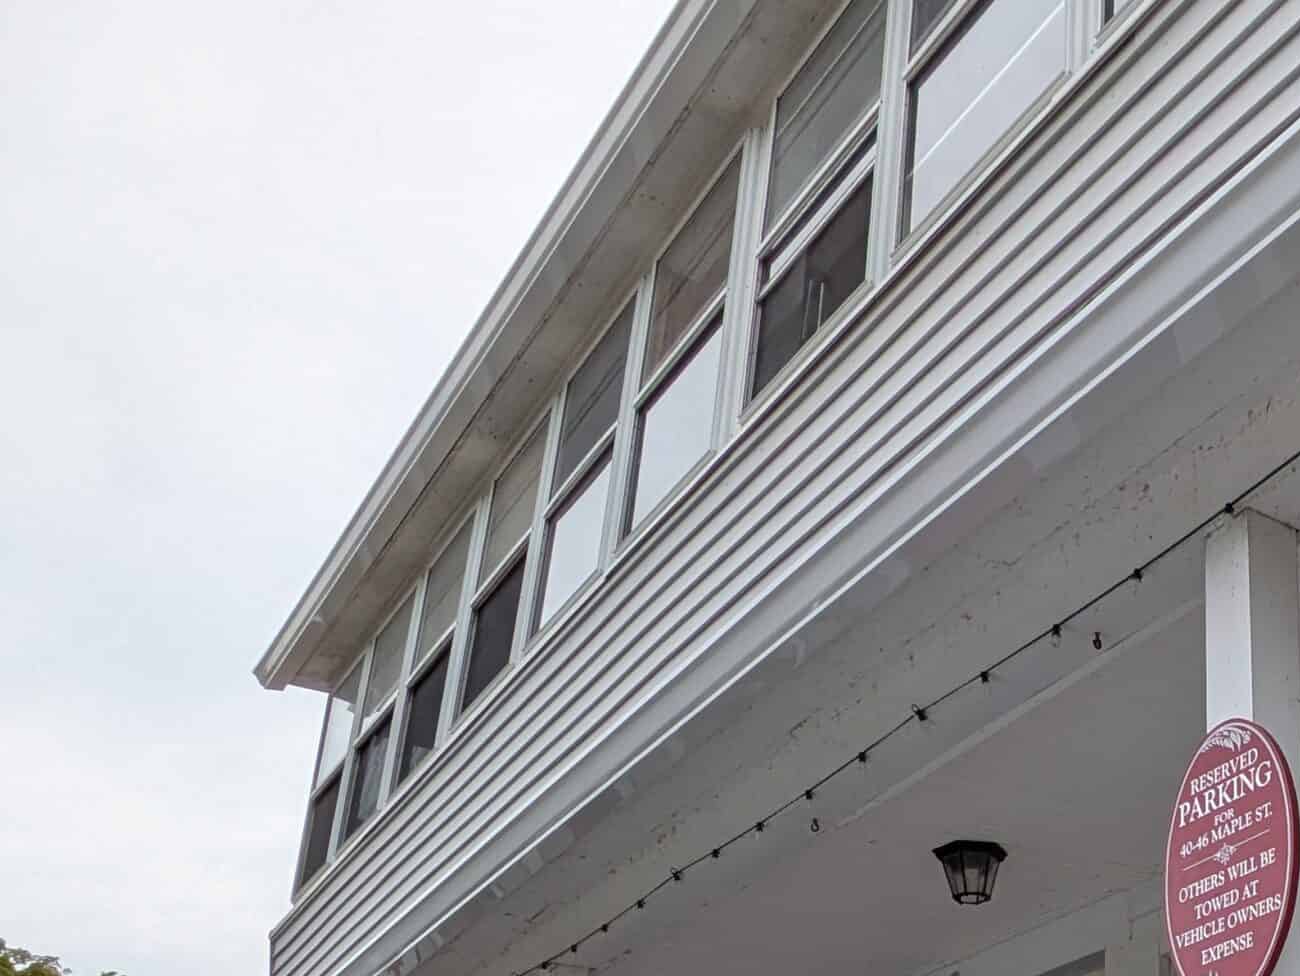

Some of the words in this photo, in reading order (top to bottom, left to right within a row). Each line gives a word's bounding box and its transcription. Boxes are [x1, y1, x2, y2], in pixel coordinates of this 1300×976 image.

[1177, 760, 1273, 828] PARKING
[1190, 748, 1258, 796] RESERVED
[1179, 833, 1209, 859] 40-46
[1211, 812, 1253, 843] MAPLE
[1255, 802, 1273, 822] ST.
[1214, 807, 1235, 827] FOR
[1178, 869, 1225, 904] OTHERS
[1227, 856, 1258, 882] WILL
[1260, 848, 1276, 865] BE
[1194, 888, 1240, 920] TOWED
[1241, 879, 1260, 898] AT
[1175, 913, 1226, 950] VEHICLE
[1227, 894, 1282, 929] OWNERS
[1201, 931, 1253, 966] EXPENSE
